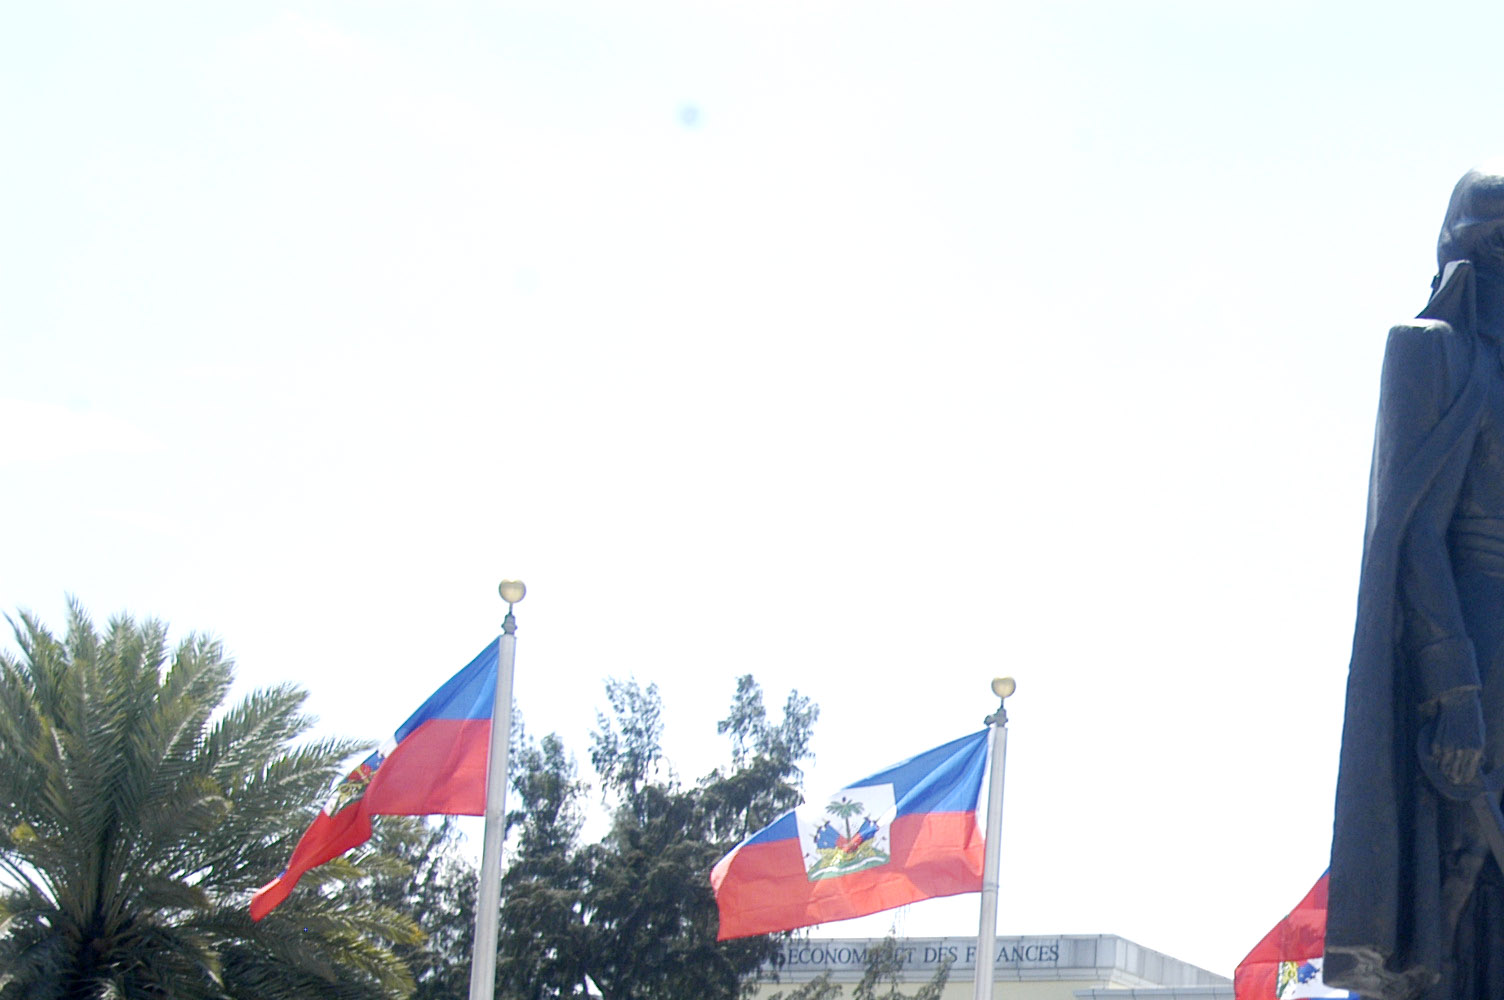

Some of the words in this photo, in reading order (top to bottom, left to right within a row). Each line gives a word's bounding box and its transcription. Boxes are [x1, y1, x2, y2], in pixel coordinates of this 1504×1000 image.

[787, 948, 883, 966] ECONOM
[924, 946, 957, 963] DES
[966, 944, 1060, 963] FANCES
